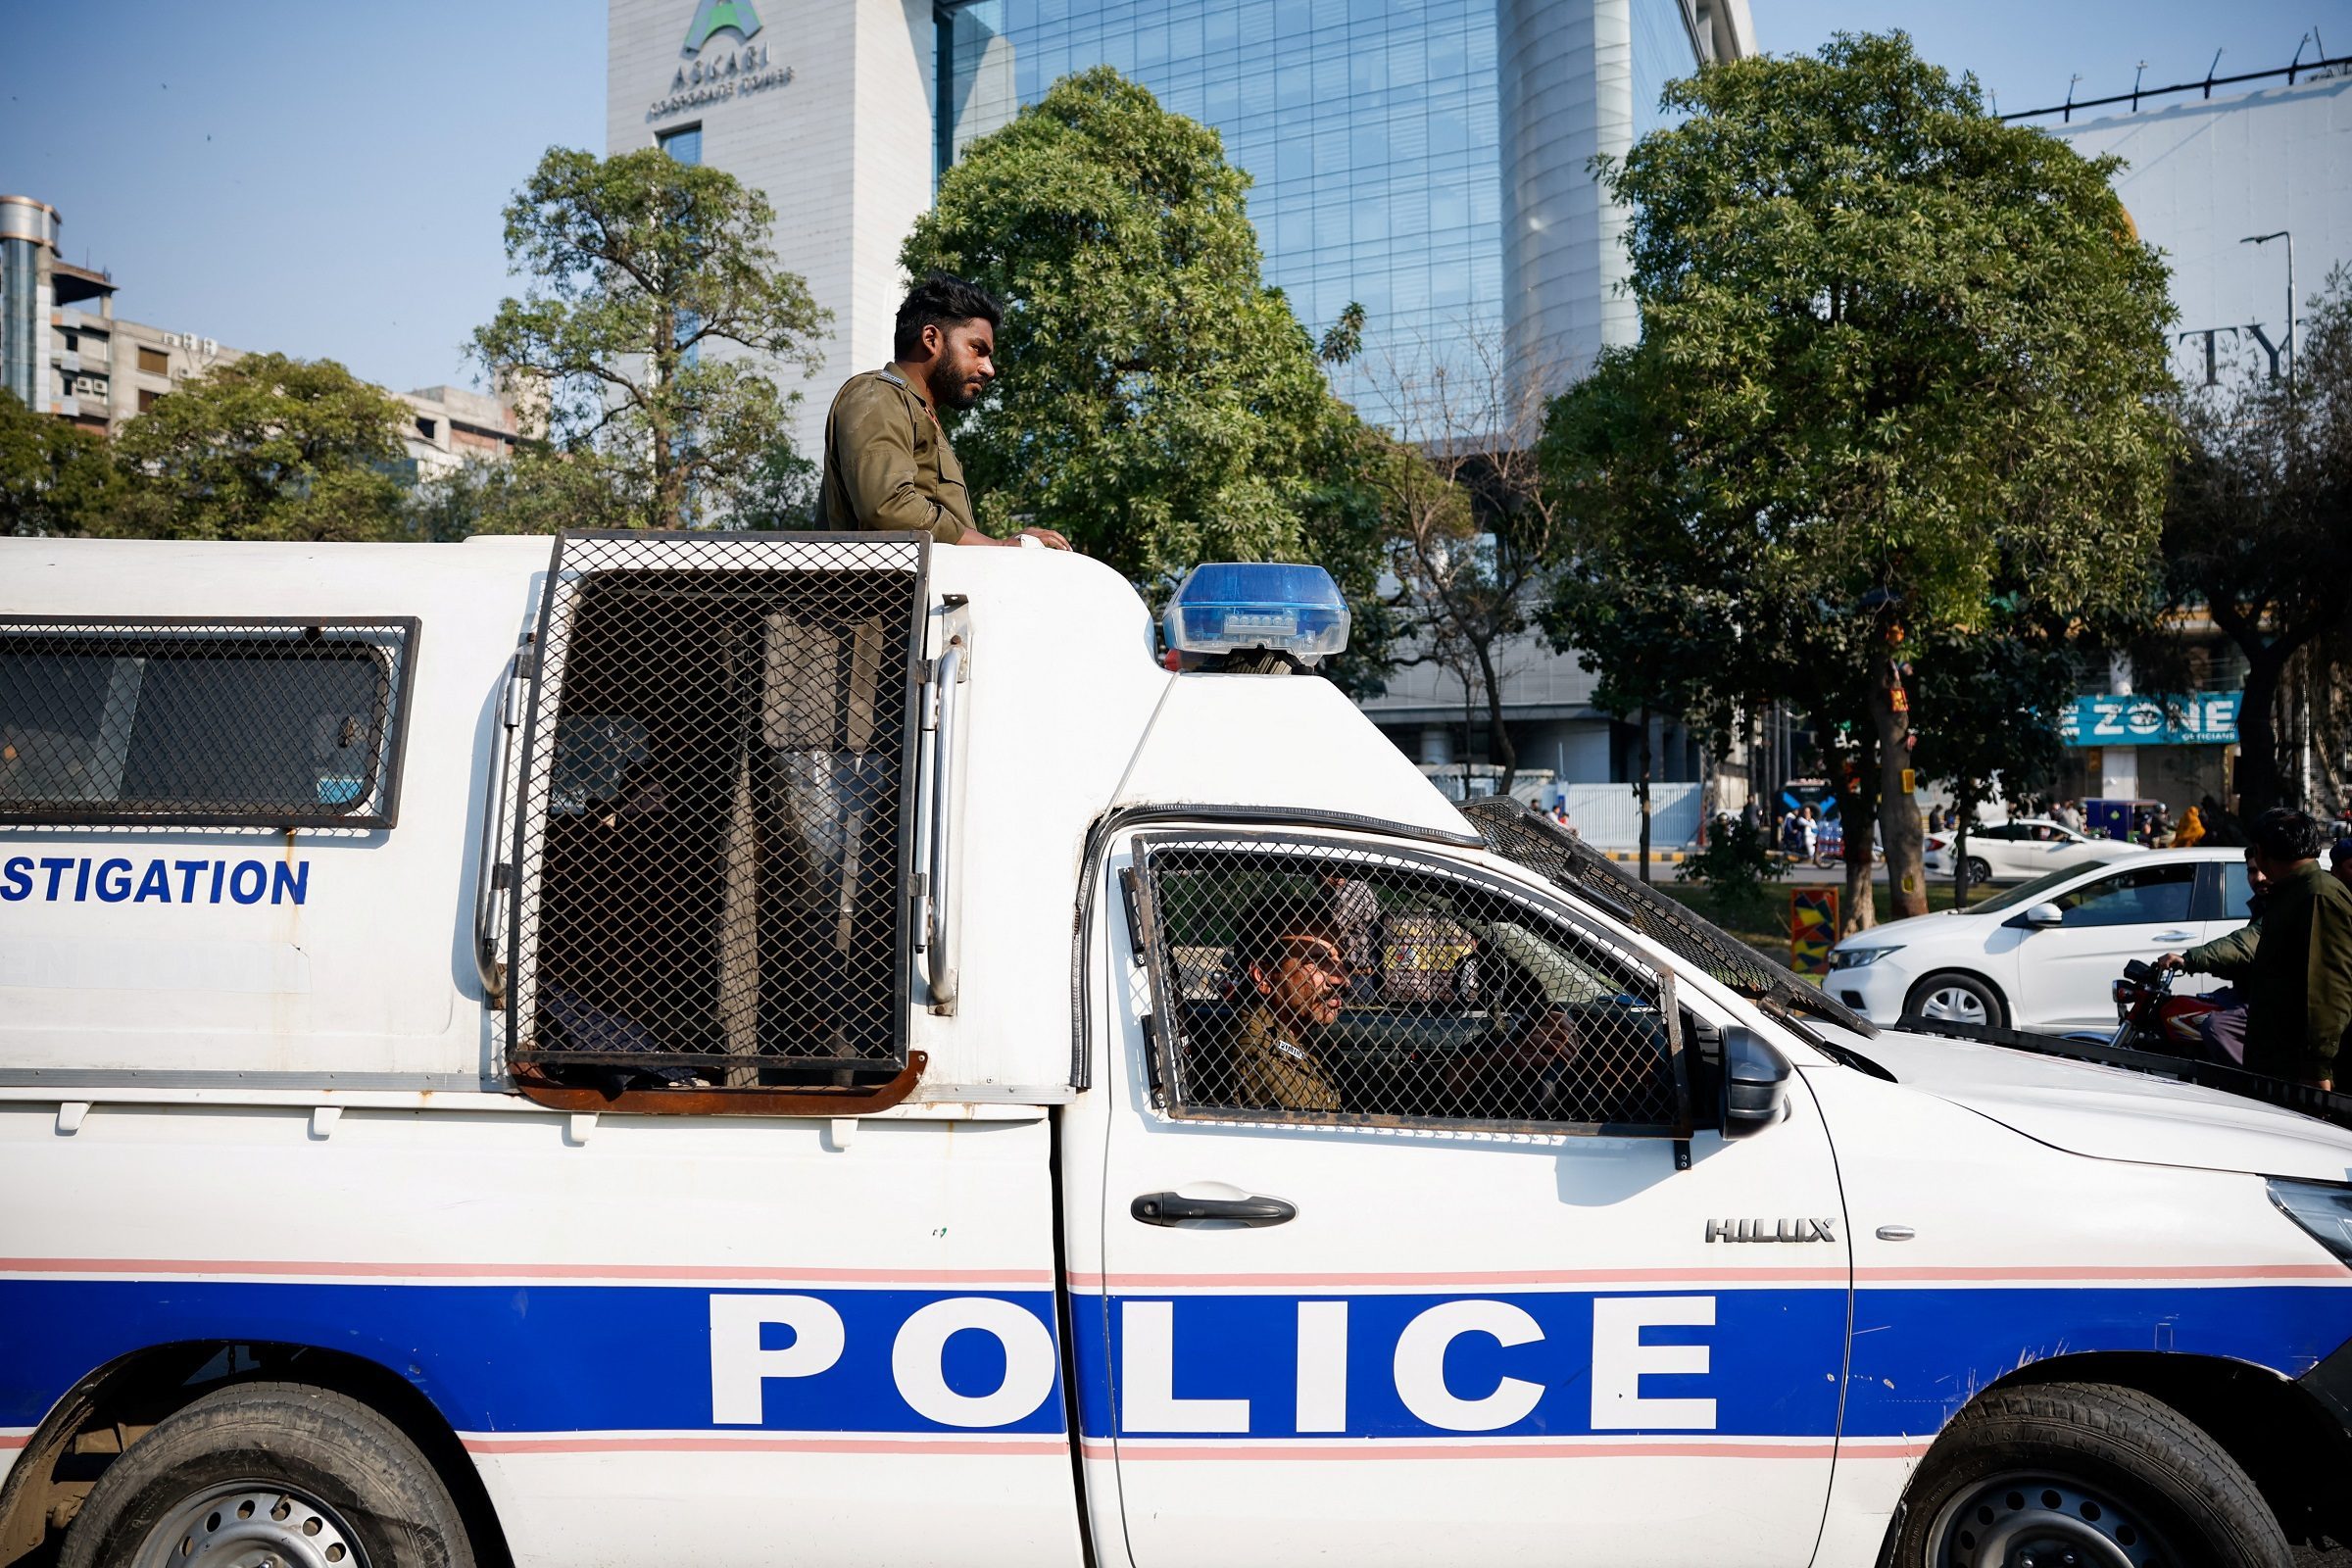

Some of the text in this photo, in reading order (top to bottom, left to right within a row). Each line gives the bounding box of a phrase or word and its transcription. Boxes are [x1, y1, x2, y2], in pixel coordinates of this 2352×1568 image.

[670, 40, 771, 91] ASKARI
[2093, 700, 2234, 735] ZONE
[0, 857, 310, 906] STIGATION
[1705, 1218, 1837, 1243] HILUX
[709, 1293, 1717, 1434] POLICE
